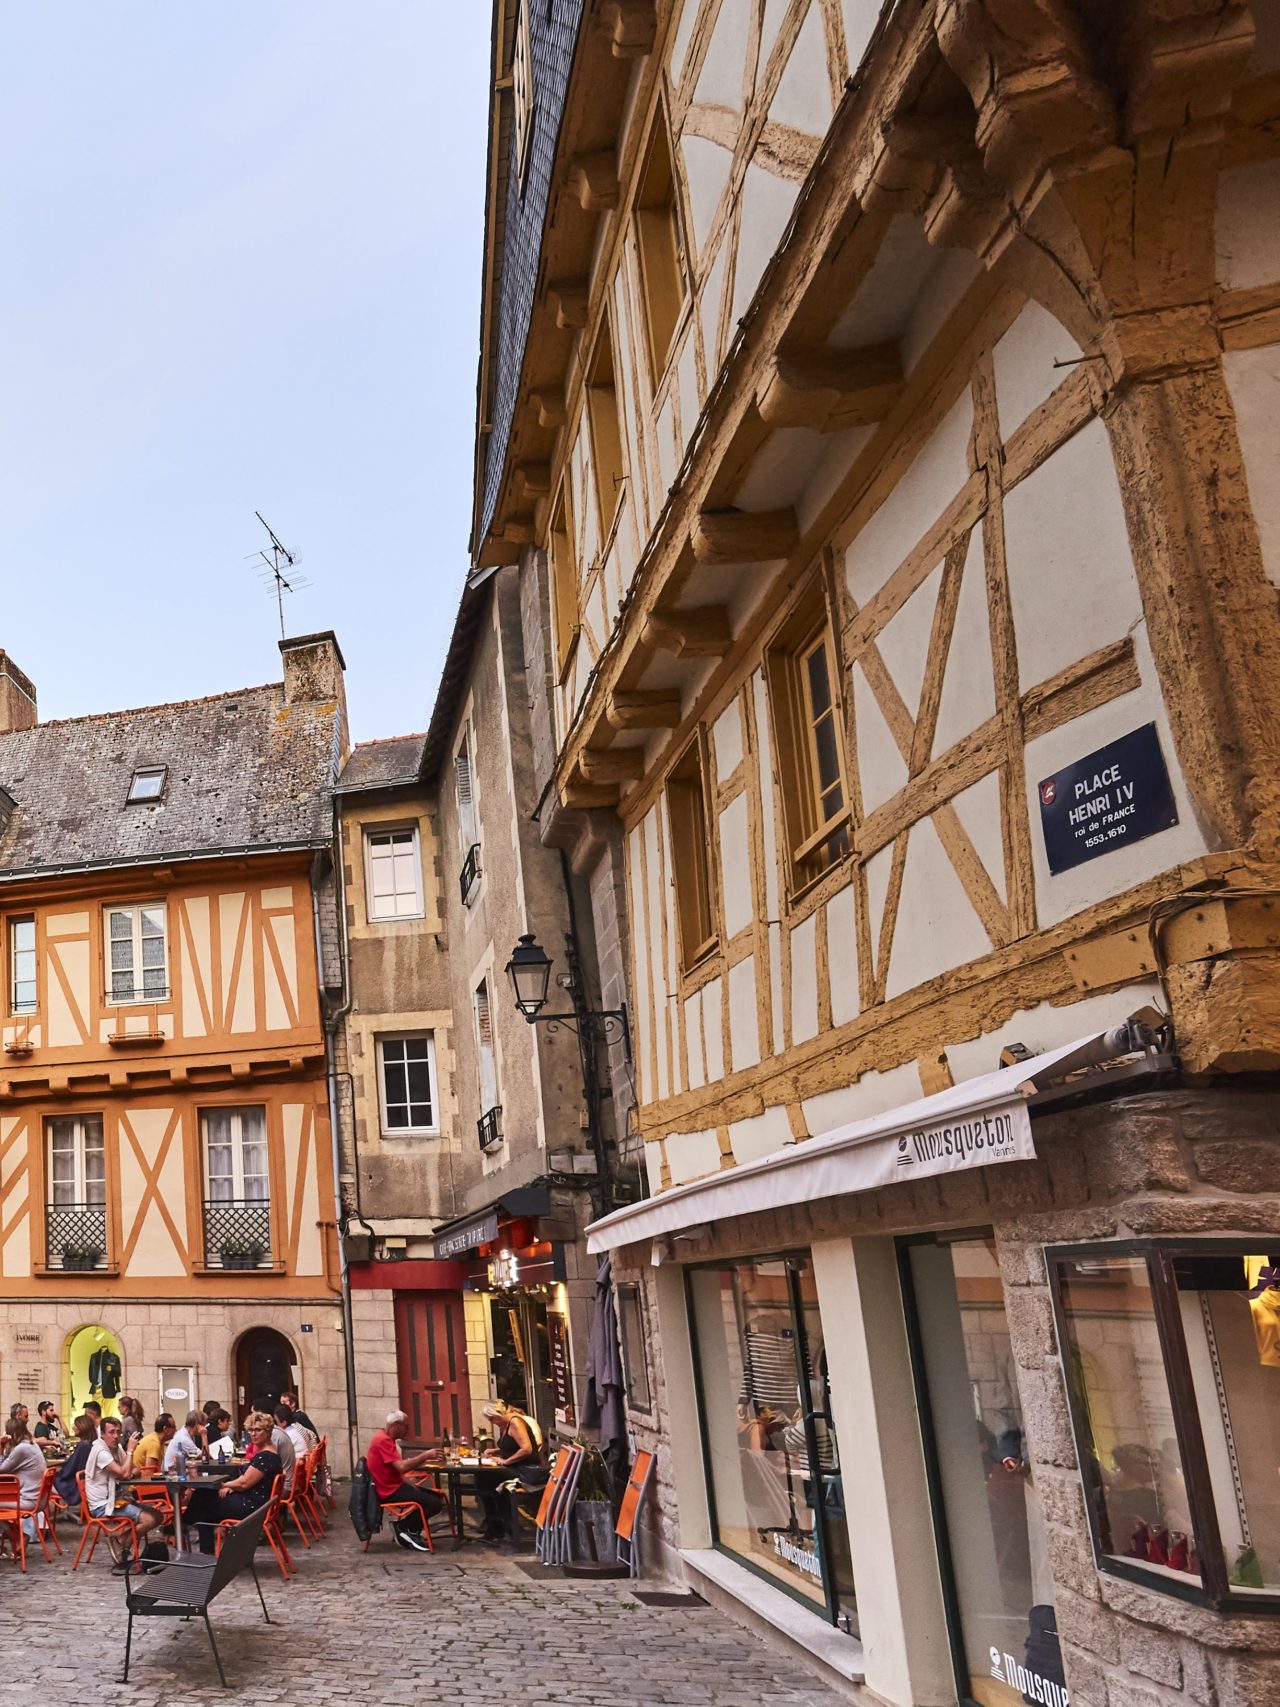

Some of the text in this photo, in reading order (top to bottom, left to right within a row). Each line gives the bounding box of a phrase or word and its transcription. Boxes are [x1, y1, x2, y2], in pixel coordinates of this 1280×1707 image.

[1074, 764, 1122, 799] PLACE
[1068, 793, 1111, 826] HENRI
[1074, 803, 1136, 839] roi de FRANCE
[1084, 824, 1127, 848] 1553.1610
[912, 1114, 1014, 1161] Mousqueton
